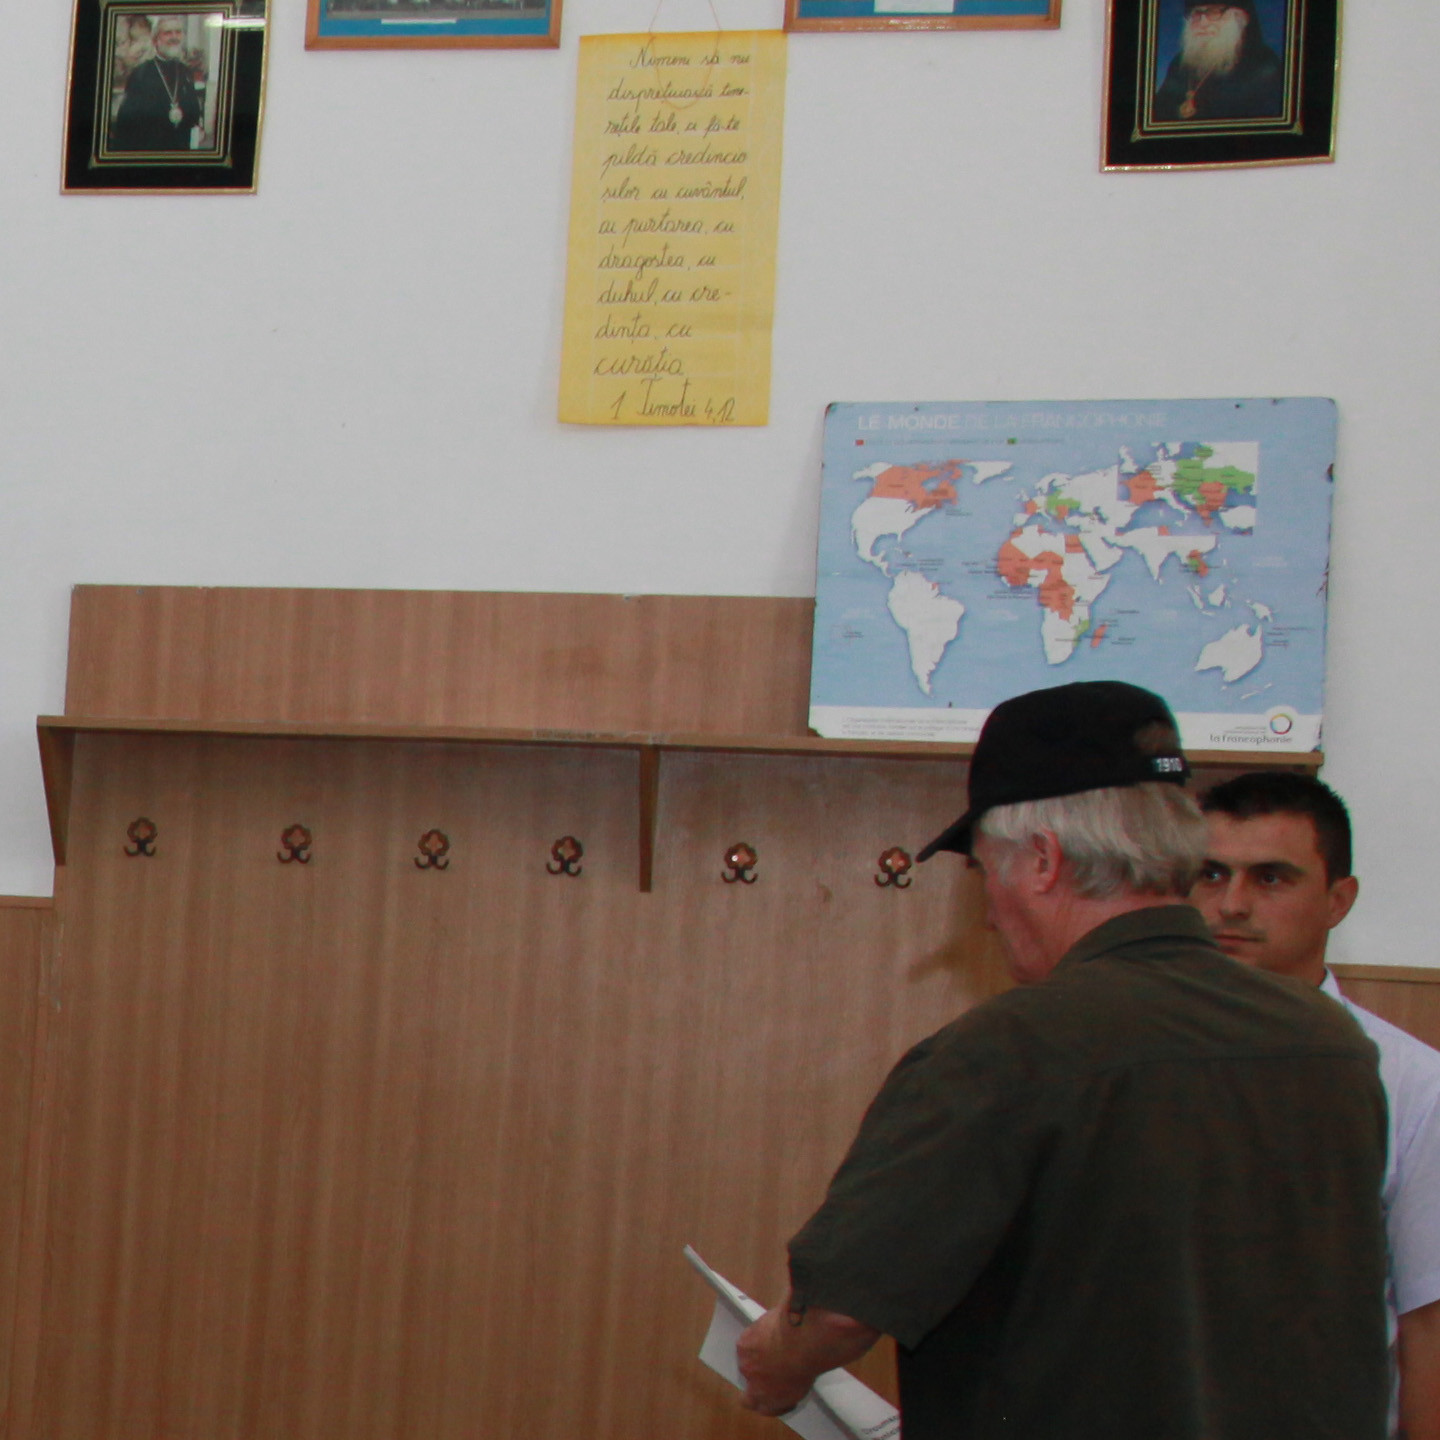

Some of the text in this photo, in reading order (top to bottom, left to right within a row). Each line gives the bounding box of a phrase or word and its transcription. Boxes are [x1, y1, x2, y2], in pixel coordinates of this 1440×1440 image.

[650, 187, 668, 200] cu
[713, 220, 735, 233] cu
[697, 255, 717, 267] cu
[661, 289, 683, 302] cu
[665, 322, 692, 339] cu
[610, 390, 627, 420] 1
[637, 378, 696, 419] Timotei
[858, 414, 881, 431] LE
[887, 413, 961, 431] MONDE
[1221, 733, 1293, 745] francophonie
